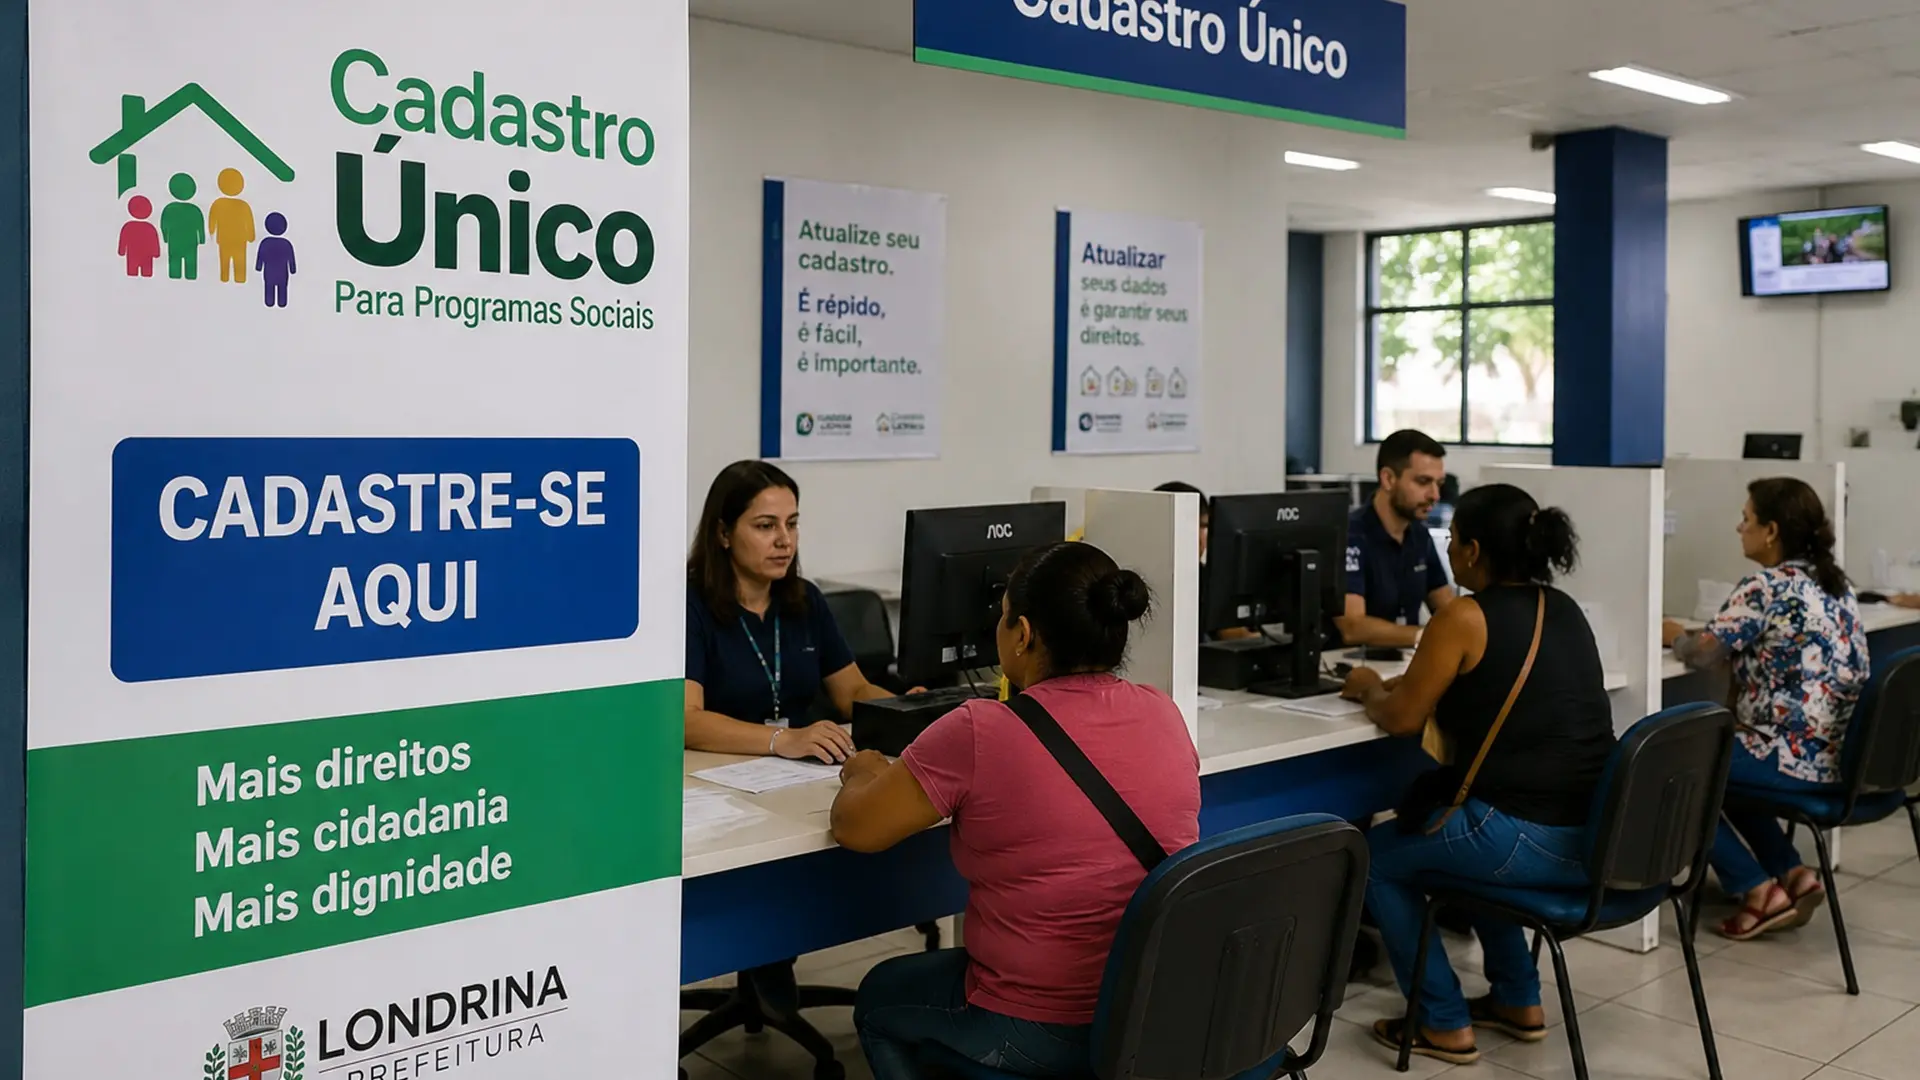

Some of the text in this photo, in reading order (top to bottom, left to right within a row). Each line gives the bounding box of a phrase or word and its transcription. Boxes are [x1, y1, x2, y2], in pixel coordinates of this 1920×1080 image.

[1239, 0, 1347, 79] Único
[331, 49, 654, 165] Cadastro
[336, 133, 654, 285] Único
[799, 220, 919, 249] Atualize seu
[799, 252, 893, 274] cadastro.
[1081, 242, 1166, 269] Atualizar
[799, 288, 810, 312] É
[1081, 275, 1167, 297] seus dados
[336, 280, 653, 329] Para Programas Sociais
[1080, 298, 1188, 322] é garantir seus
[798, 321, 862, 347] é fácil,
[1080, 325, 1145, 346] direitos.
[797, 351, 921, 377] é importante.
[159, 471, 605, 540] CADASTRE-SE
[1277, 507, 1299, 520] AOC
[987, 524, 1012, 539] AOC
[315, 560, 476, 630] AQUI
[198, 739, 470, 806] Mais direitos
[196, 790, 507, 872] Mais cidadania
[195, 845, 512, 937] Mais dignidade
[319, 966, 567, 1061] LONDRINA
